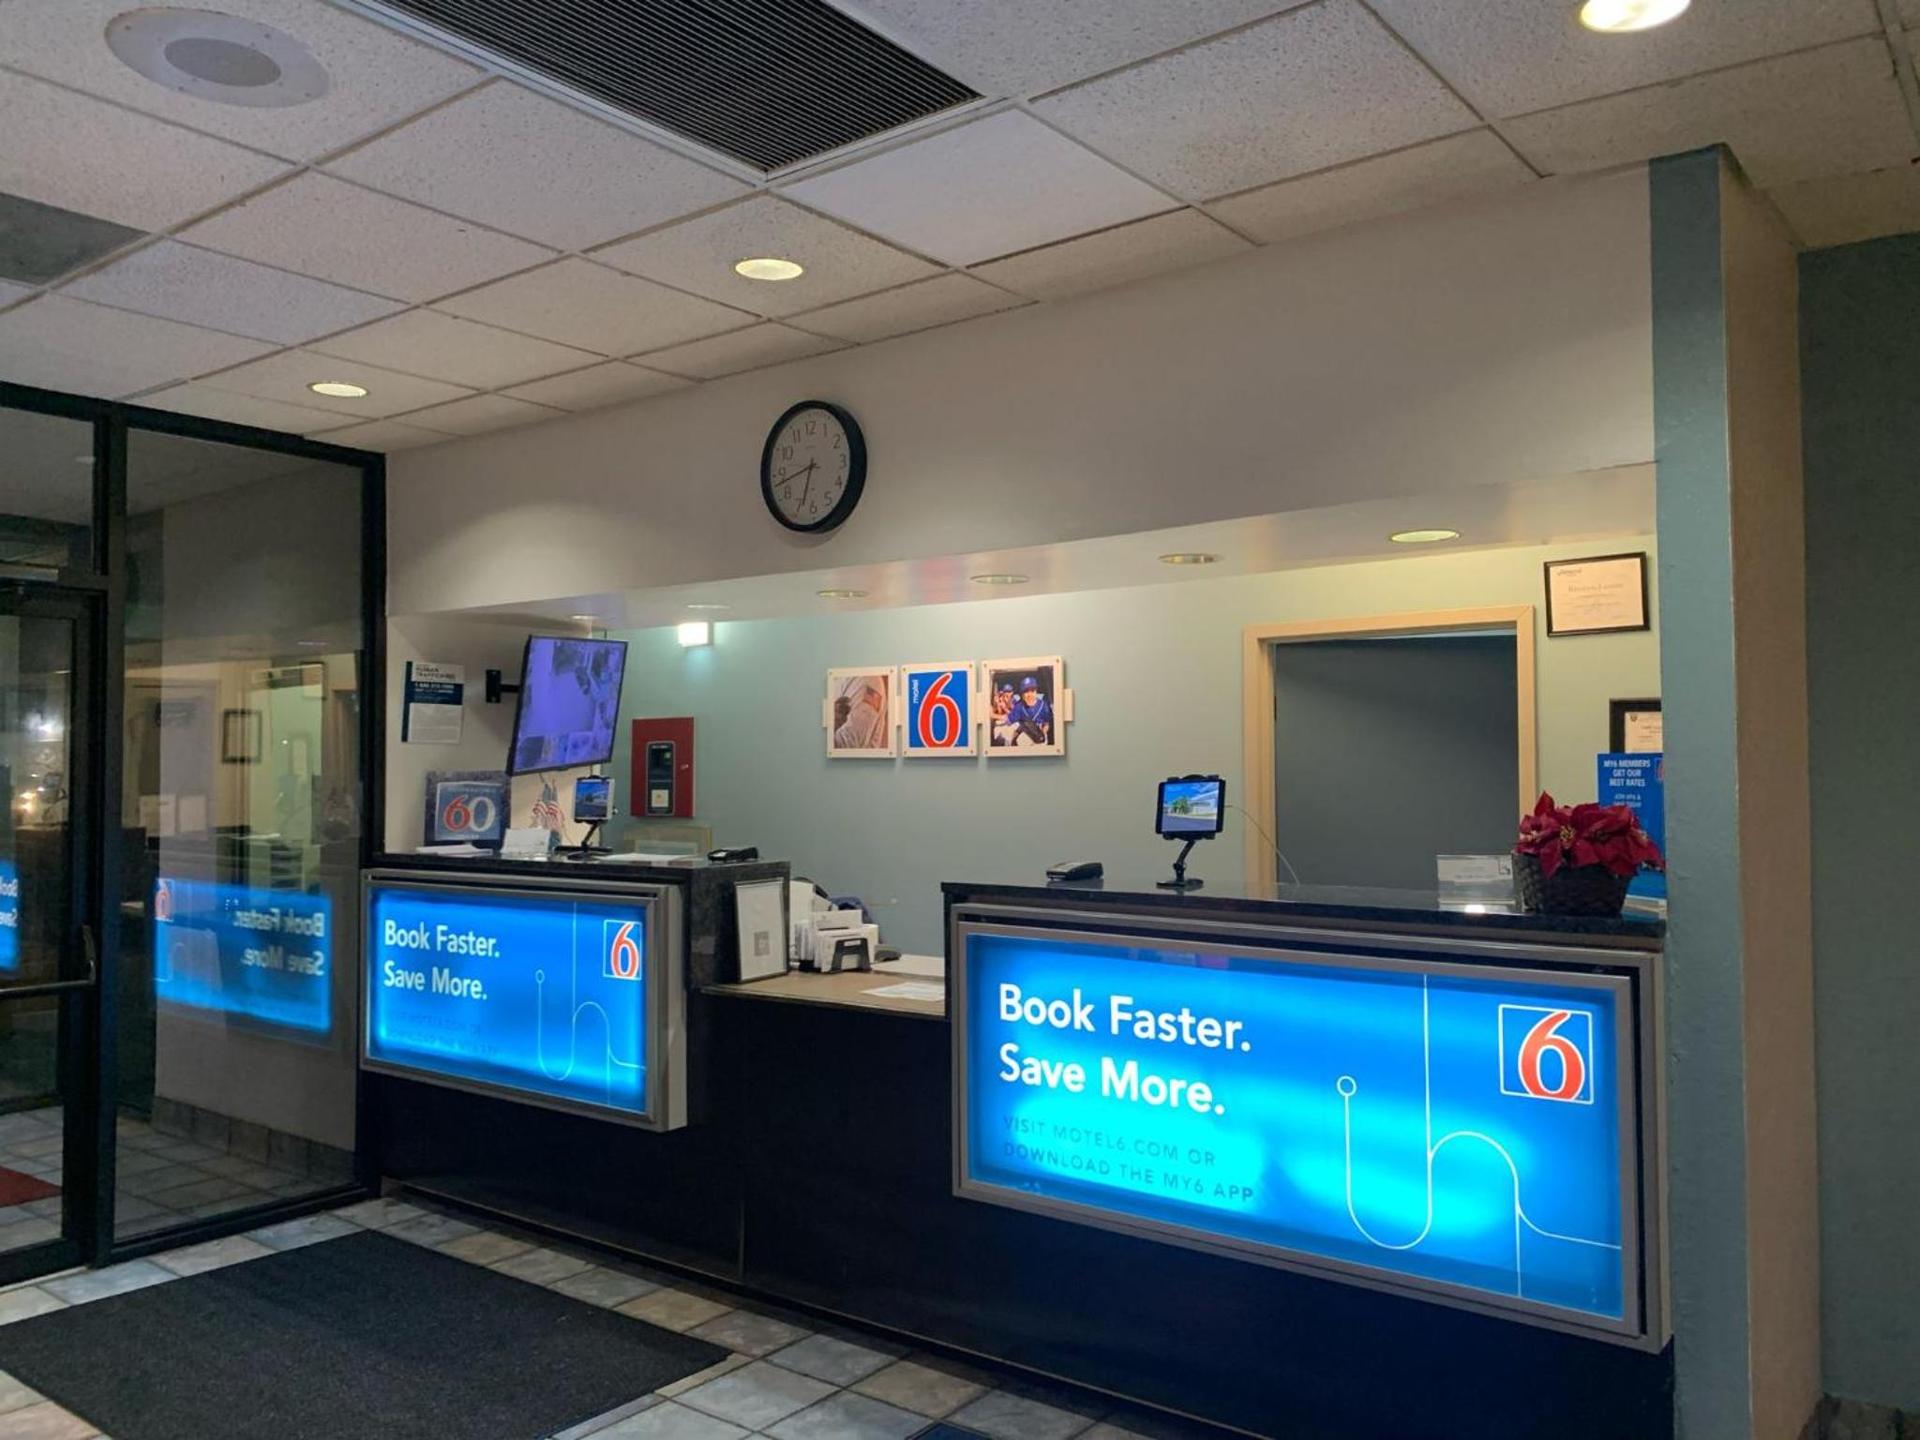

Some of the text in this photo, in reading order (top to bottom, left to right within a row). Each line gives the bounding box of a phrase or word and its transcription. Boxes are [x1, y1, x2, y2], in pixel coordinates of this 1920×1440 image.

[805, 421, 816, 435] 12
[792, 430, 800, 443] 11
[833, 434, 841, 449] 2
[782, 446, 794, 461] 10
[840, 454, 846, 469] 3
[778, 467, 786, 481] 9
[834, 475, 842, 489] 4
[784, 486, 792, 500] 8
[824, 492, 832, 506] 5
[810, 501, 817, 514] 6
[912, 678, 920, 704] motel
[918, 672, 962, 748] 6
[1618, 759, 1651, 768] MEMBERS
[1612, 768, 1642, 777] GET OUR
[1609, 778, 1646, 787] BEST RATES
[443, 795, 496, 832] 60
[384, 919, 500, 958] Book Faster.
[610, 922, 640, 978] 6
[383, 960, 488, 1000] Save More.
[999, 982, 1251, 1052] Book Faster.
[1518, 1010, 1586, 1100] 6
[999, 1042, 1225, 1116] Save More.
[1004, 1114, 1045, 1134] VISIT
[1188, 1148, 1215, 1167] OR
[1004, 1142, 1254, 1202] DOWNLOAD THE MY6 APP
